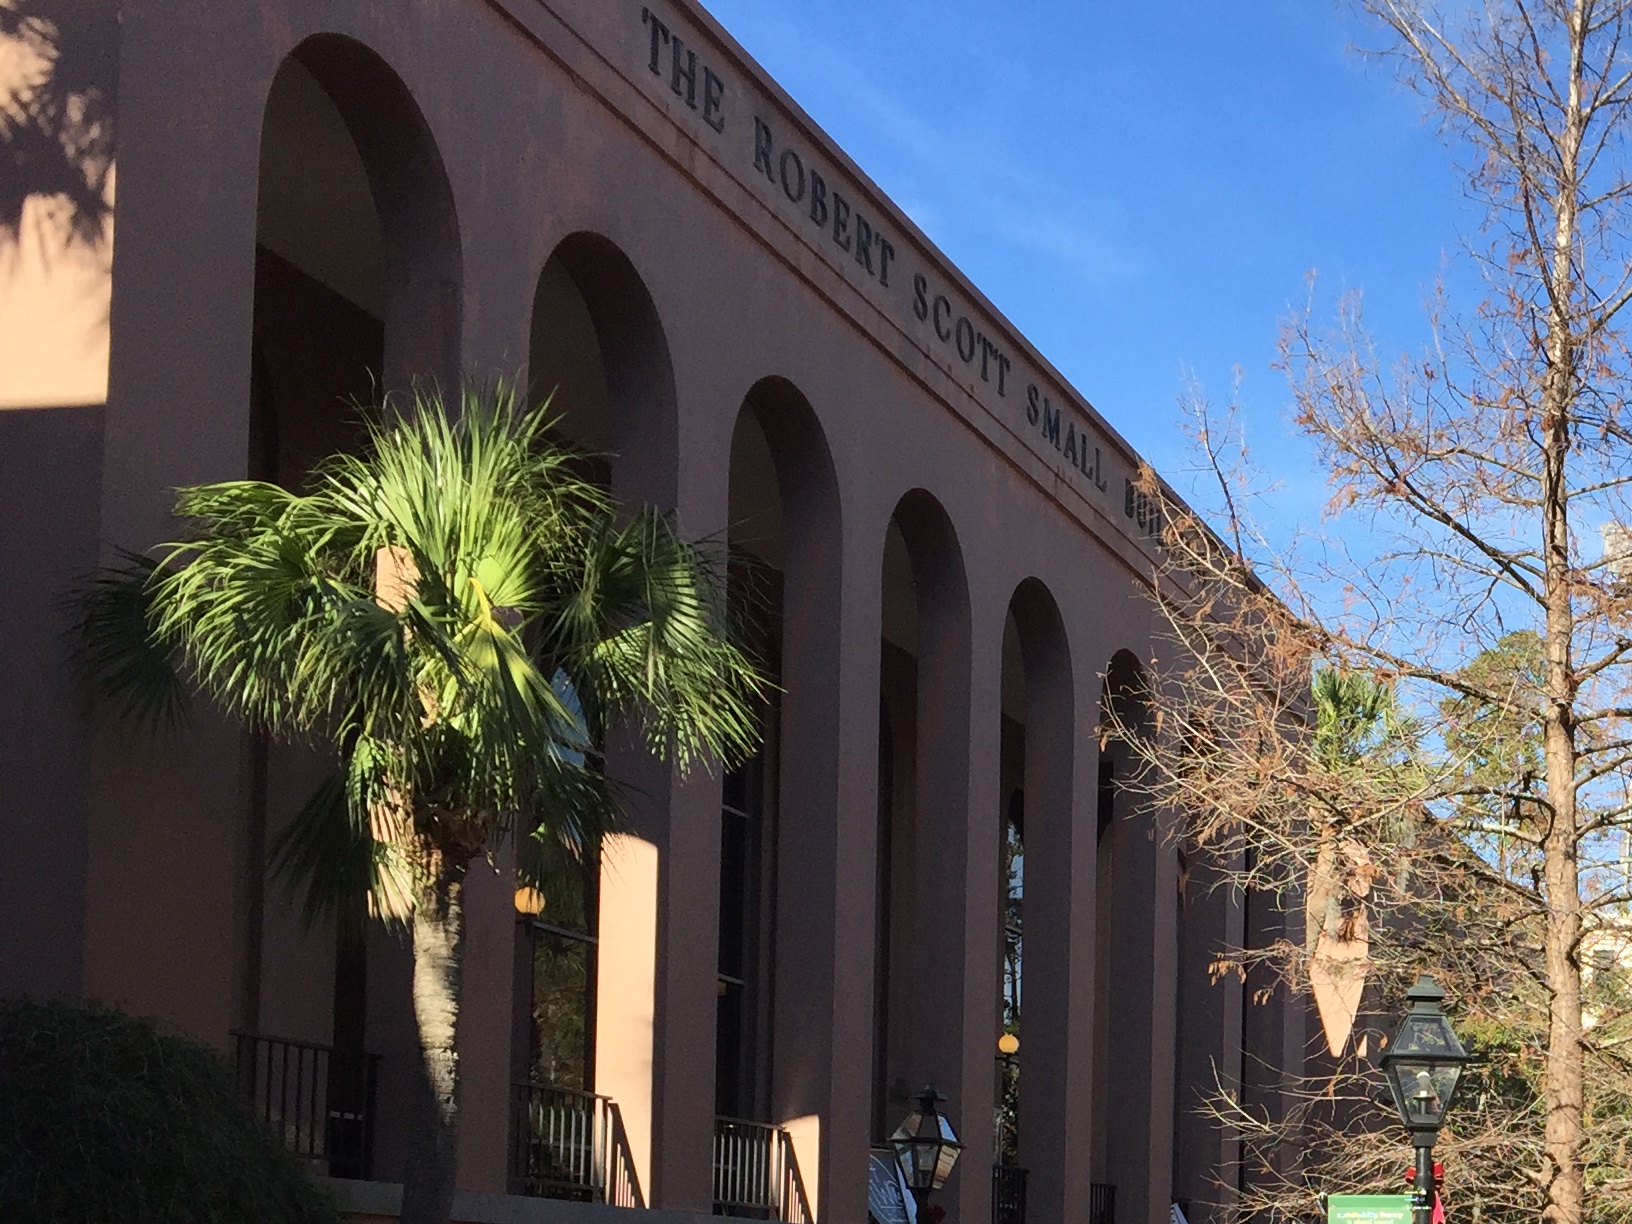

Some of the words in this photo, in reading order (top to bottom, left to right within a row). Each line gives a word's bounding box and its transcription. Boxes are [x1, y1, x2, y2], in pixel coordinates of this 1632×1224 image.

[642, 6, 725, 134] THE
[753, 115, 895, 288] ROBERT
[912, 273, 1011, 398] SCOTT
[1026, 382, 1109, 494] SMALL
